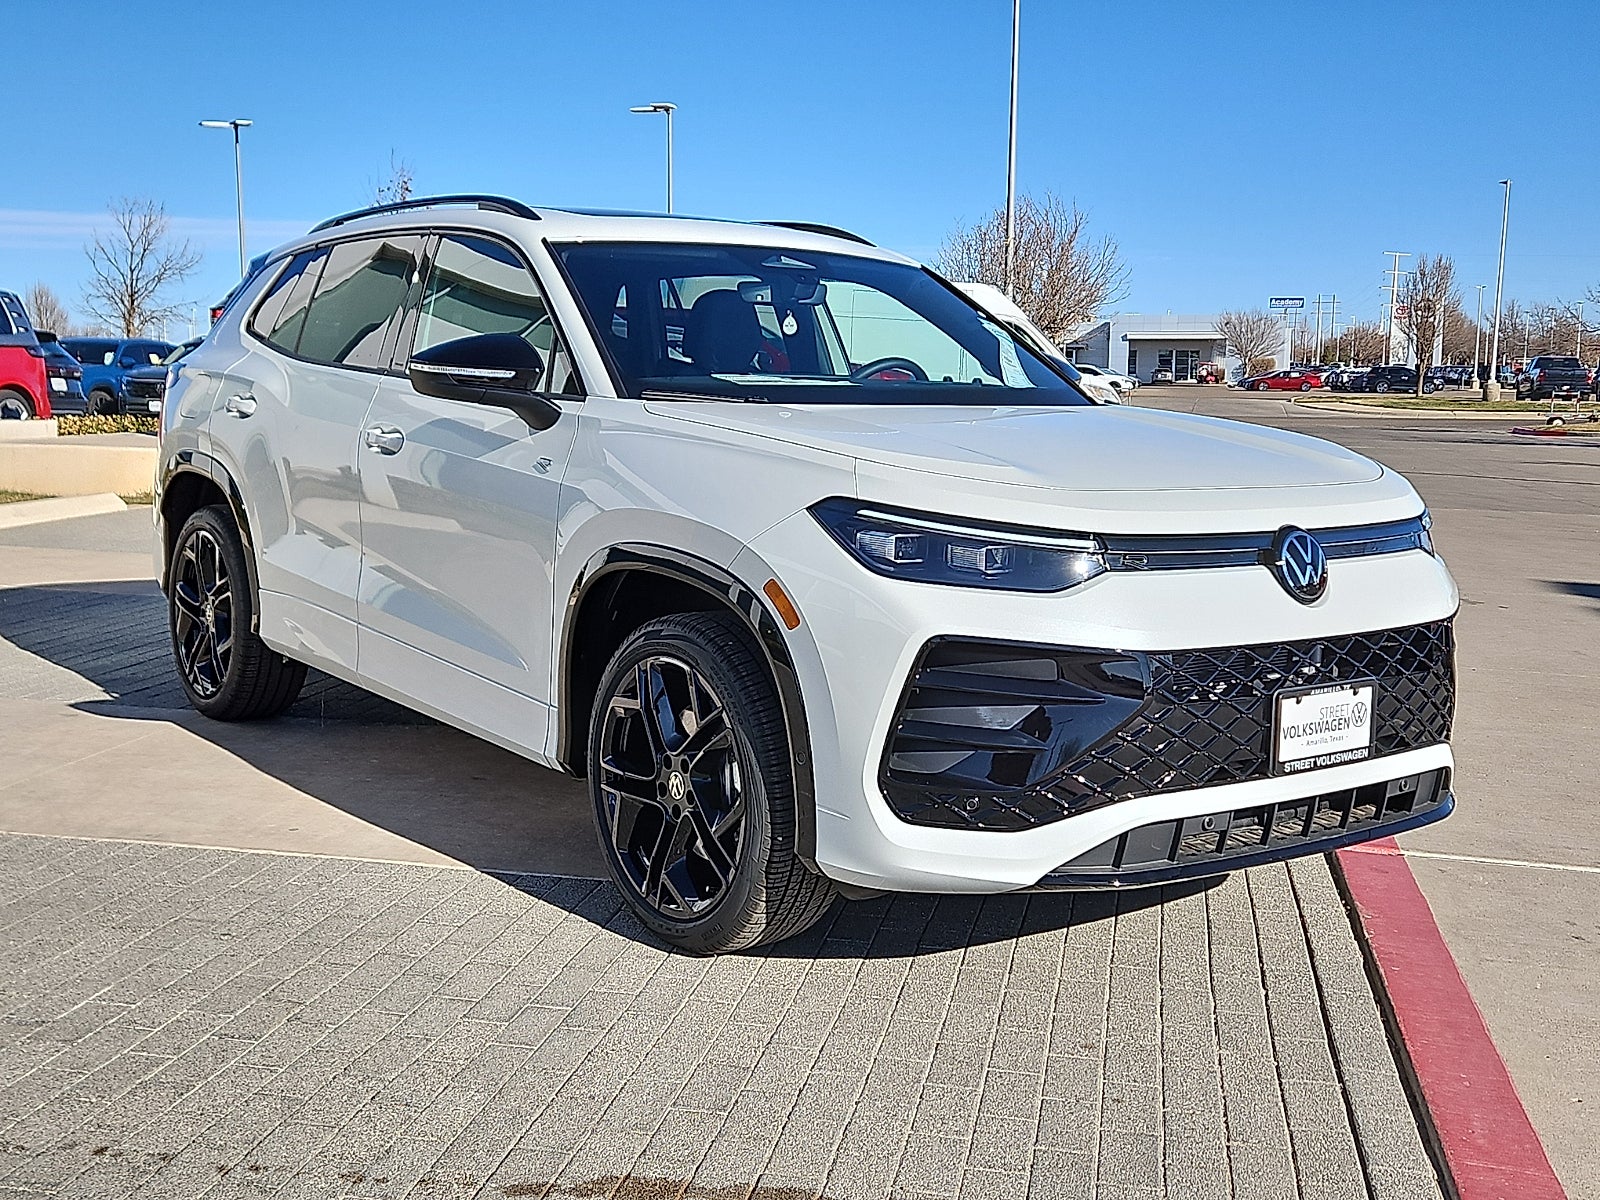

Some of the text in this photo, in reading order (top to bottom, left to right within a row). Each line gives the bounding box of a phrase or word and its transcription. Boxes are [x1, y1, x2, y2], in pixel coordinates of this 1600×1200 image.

[1271, 299, 1303, 307] Academy
[1320, 703, 1351, 721] STREET
[1282, 717, 1351, 741] VOLKSWAGEN
[1284, 748, 1369, 773] STREET VOLKSWAGEN
